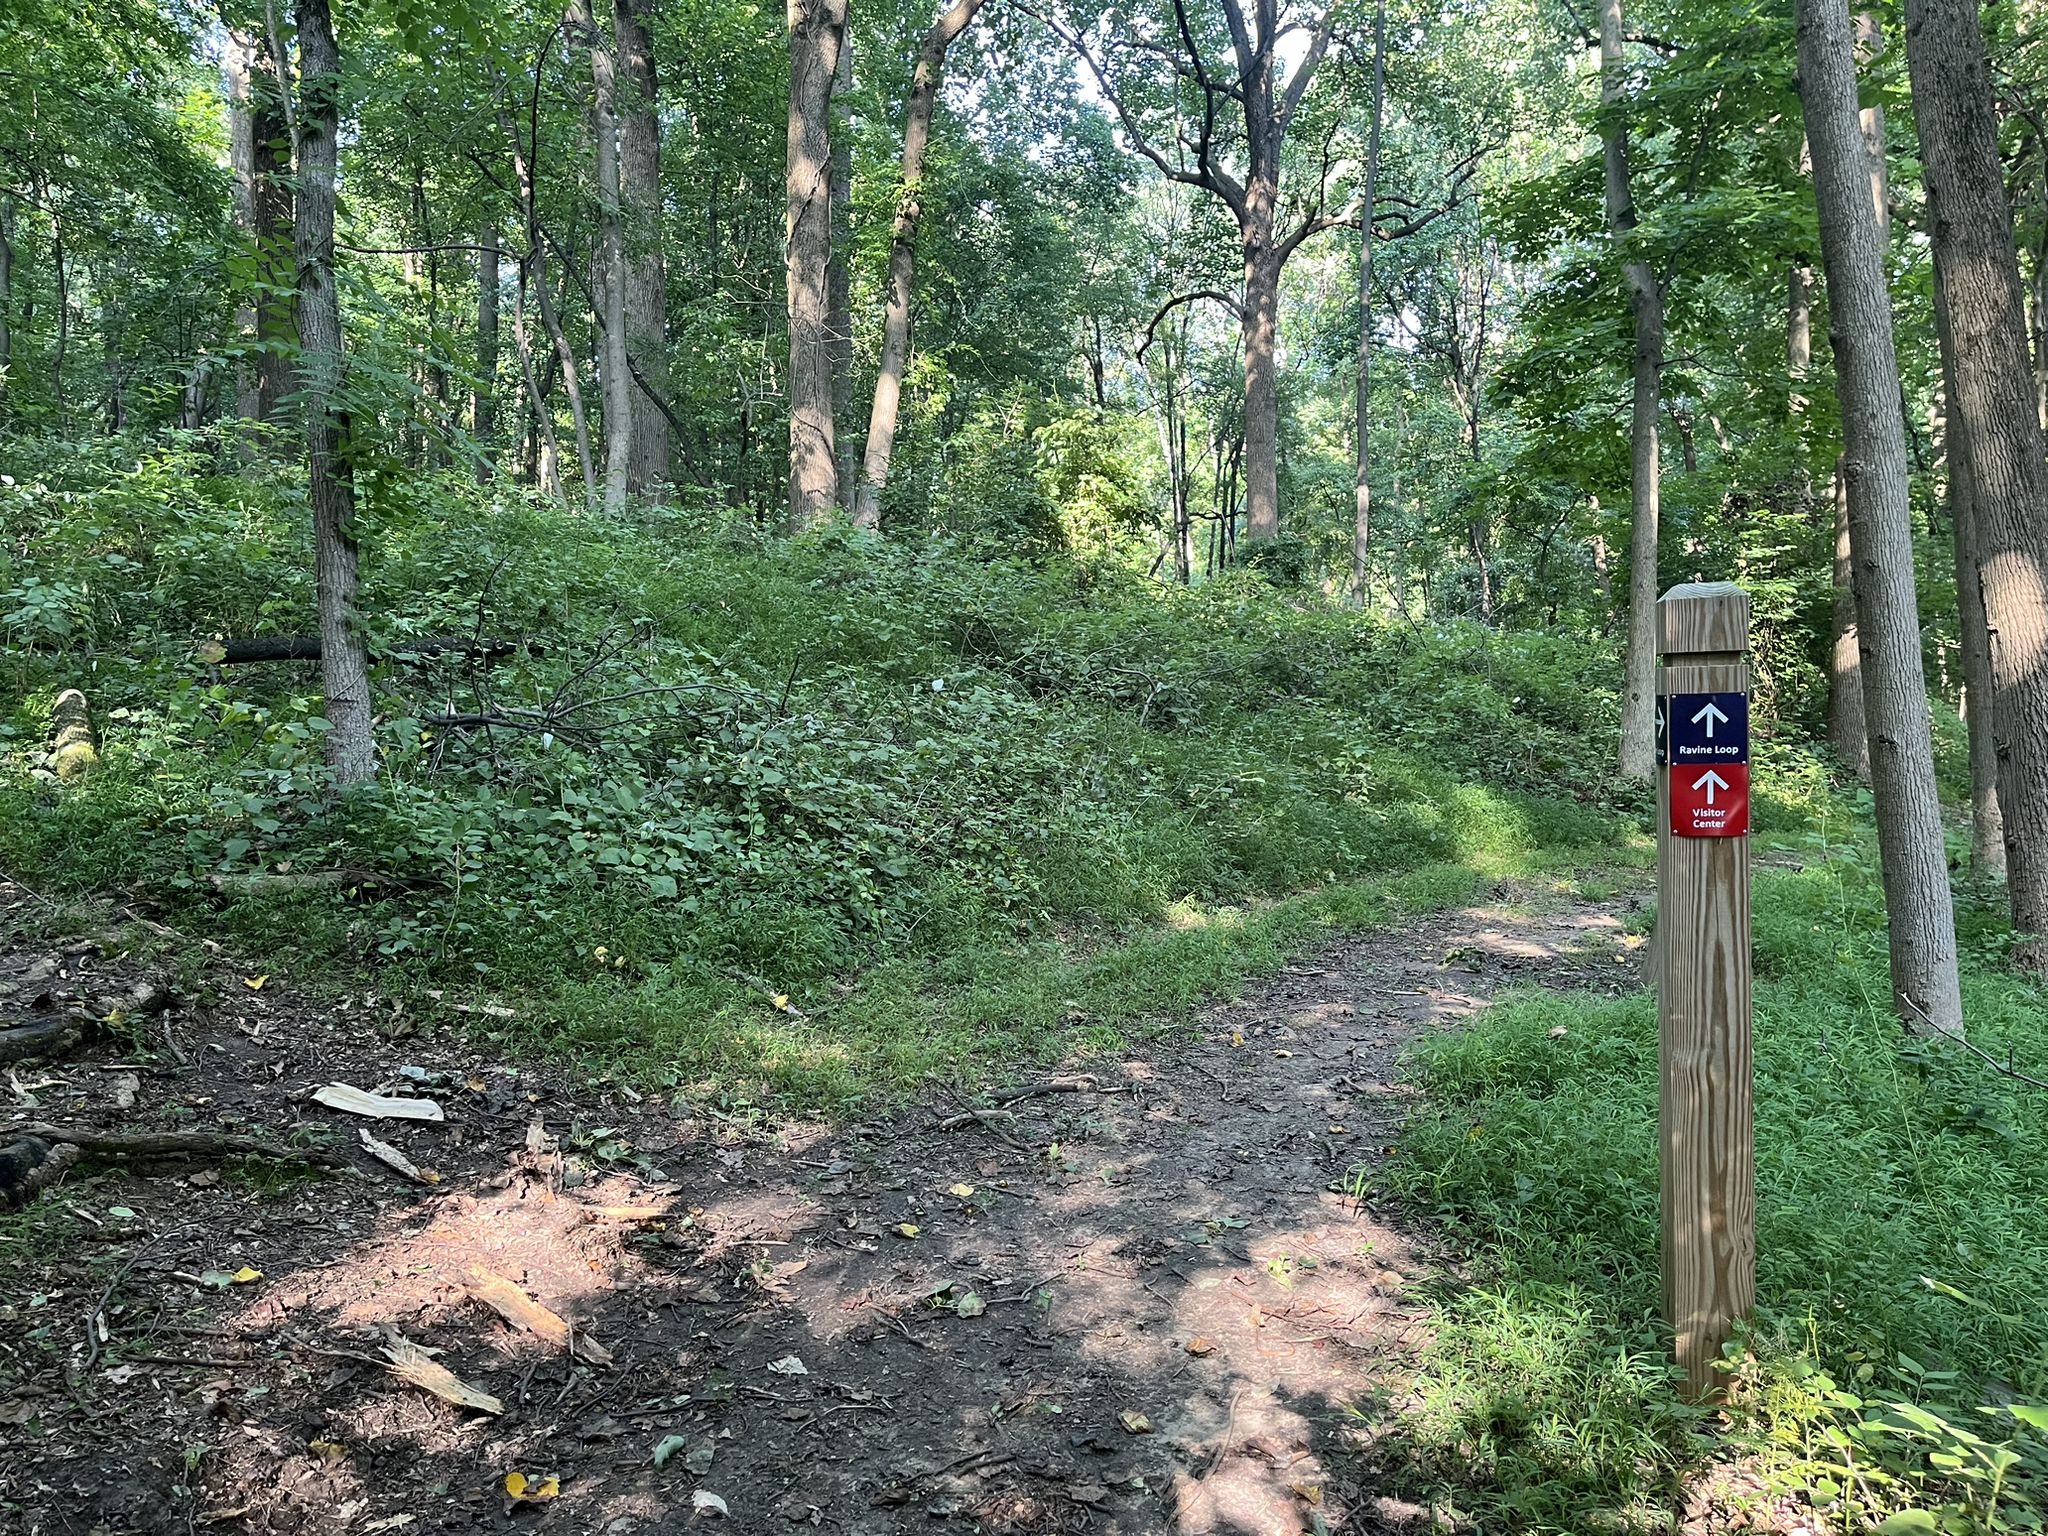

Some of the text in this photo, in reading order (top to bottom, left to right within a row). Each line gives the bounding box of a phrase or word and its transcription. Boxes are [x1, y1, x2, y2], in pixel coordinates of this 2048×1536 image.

[1679, 745, 1739, 755] Ravine Loop
[1692, 808, 1726, 817] Visitor
[1692, 819, 1726, 828] Center
